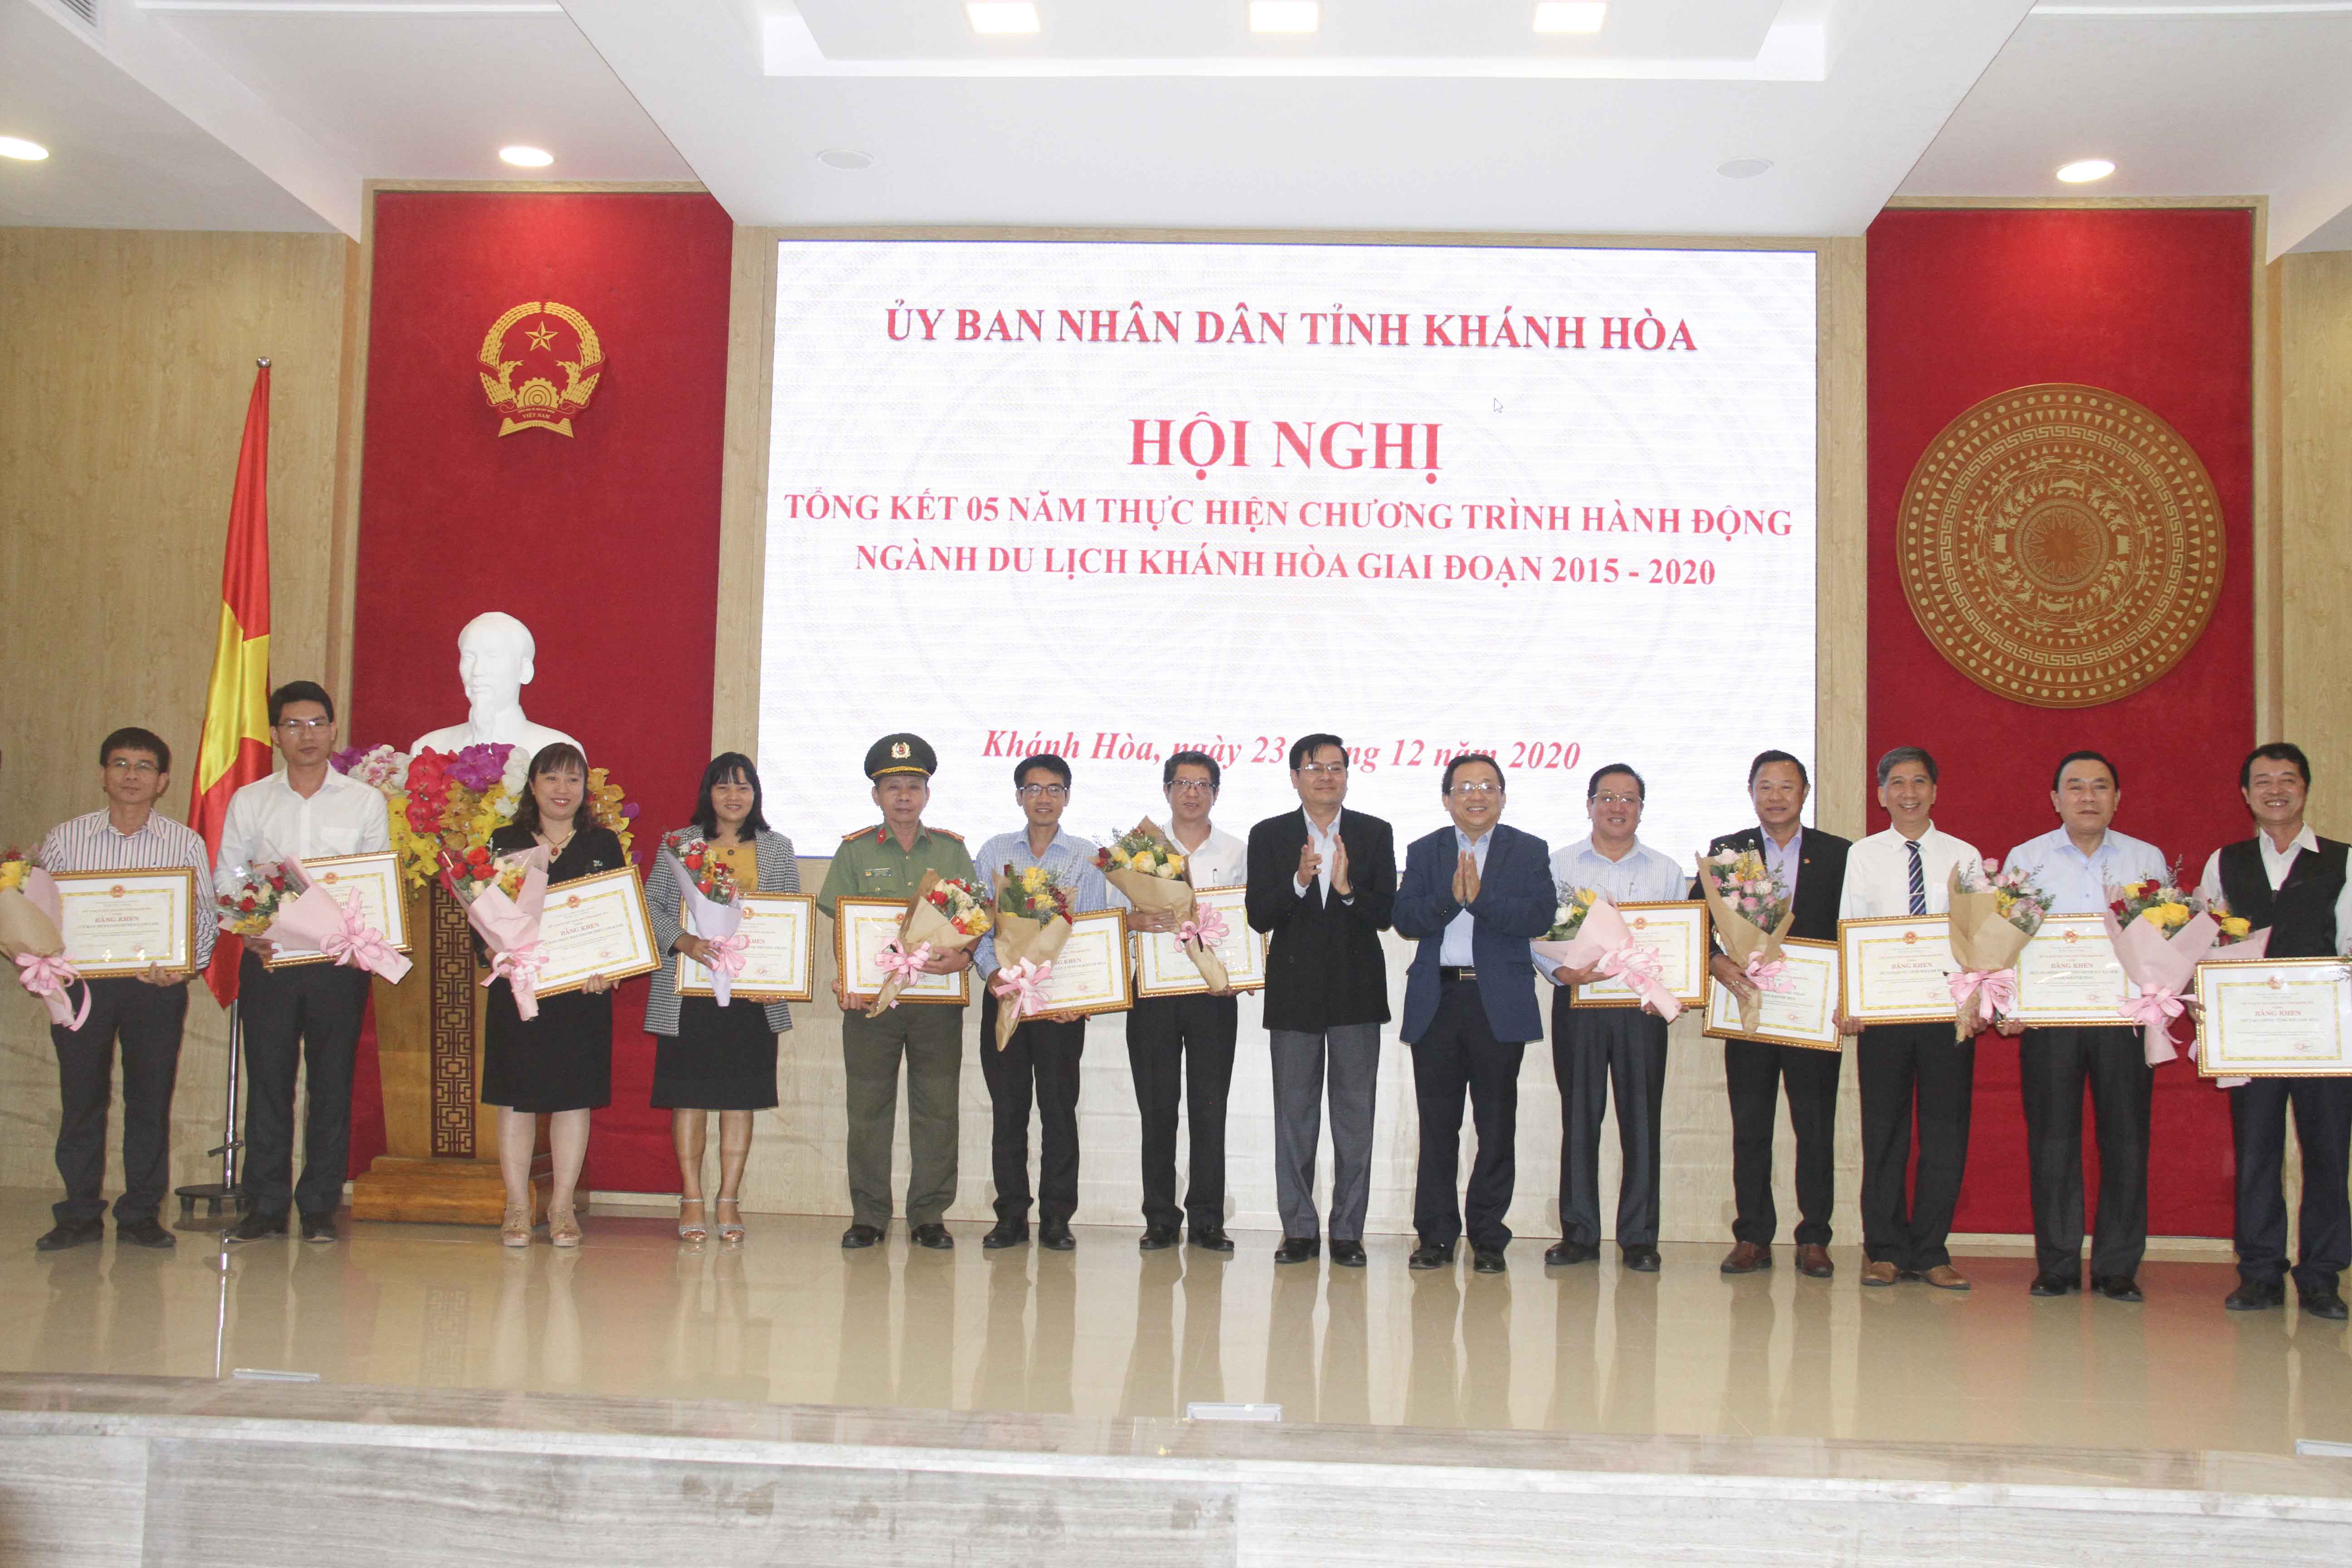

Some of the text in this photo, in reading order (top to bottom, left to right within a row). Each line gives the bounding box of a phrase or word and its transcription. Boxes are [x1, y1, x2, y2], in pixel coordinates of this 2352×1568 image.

[887, 299, 1697, 352] ỦY BAN NHÂN DÂN TỈNH KHÁNH HÒA
[1128, 410, 1443, 485] HỘI NGHỊ
[784, 485, 1792, 543] TỔNG KẾT 05 NĂM THỰC HIỆN CHƯƠNG TRÌNH HÀNH ĐỘNG
[855, 537, 978, 572] NGÀNH
[988, 546, 1034, 574] DU
[1044, 547, 1127, 581] LỊCH
[1139, 541, 1265, 578] KHÁNH
[1274, 543, 1349, 579] HÒA
[1357, 552, 1433, 581] GIAI
[1445, 554, 1543, 588] ĐOẠN
[1552, 555, 1620, 584] 2015
[1648, 558, 1716, 586] 2020
[982, 730, 1080, 759] Khánh
[1091, 732, 1161, 764] Hòa,
[1250, 736, 1287, 764] 23
[1390, 739, 1425, 767] 12
[1509, 740, 1581, 770] 2020
